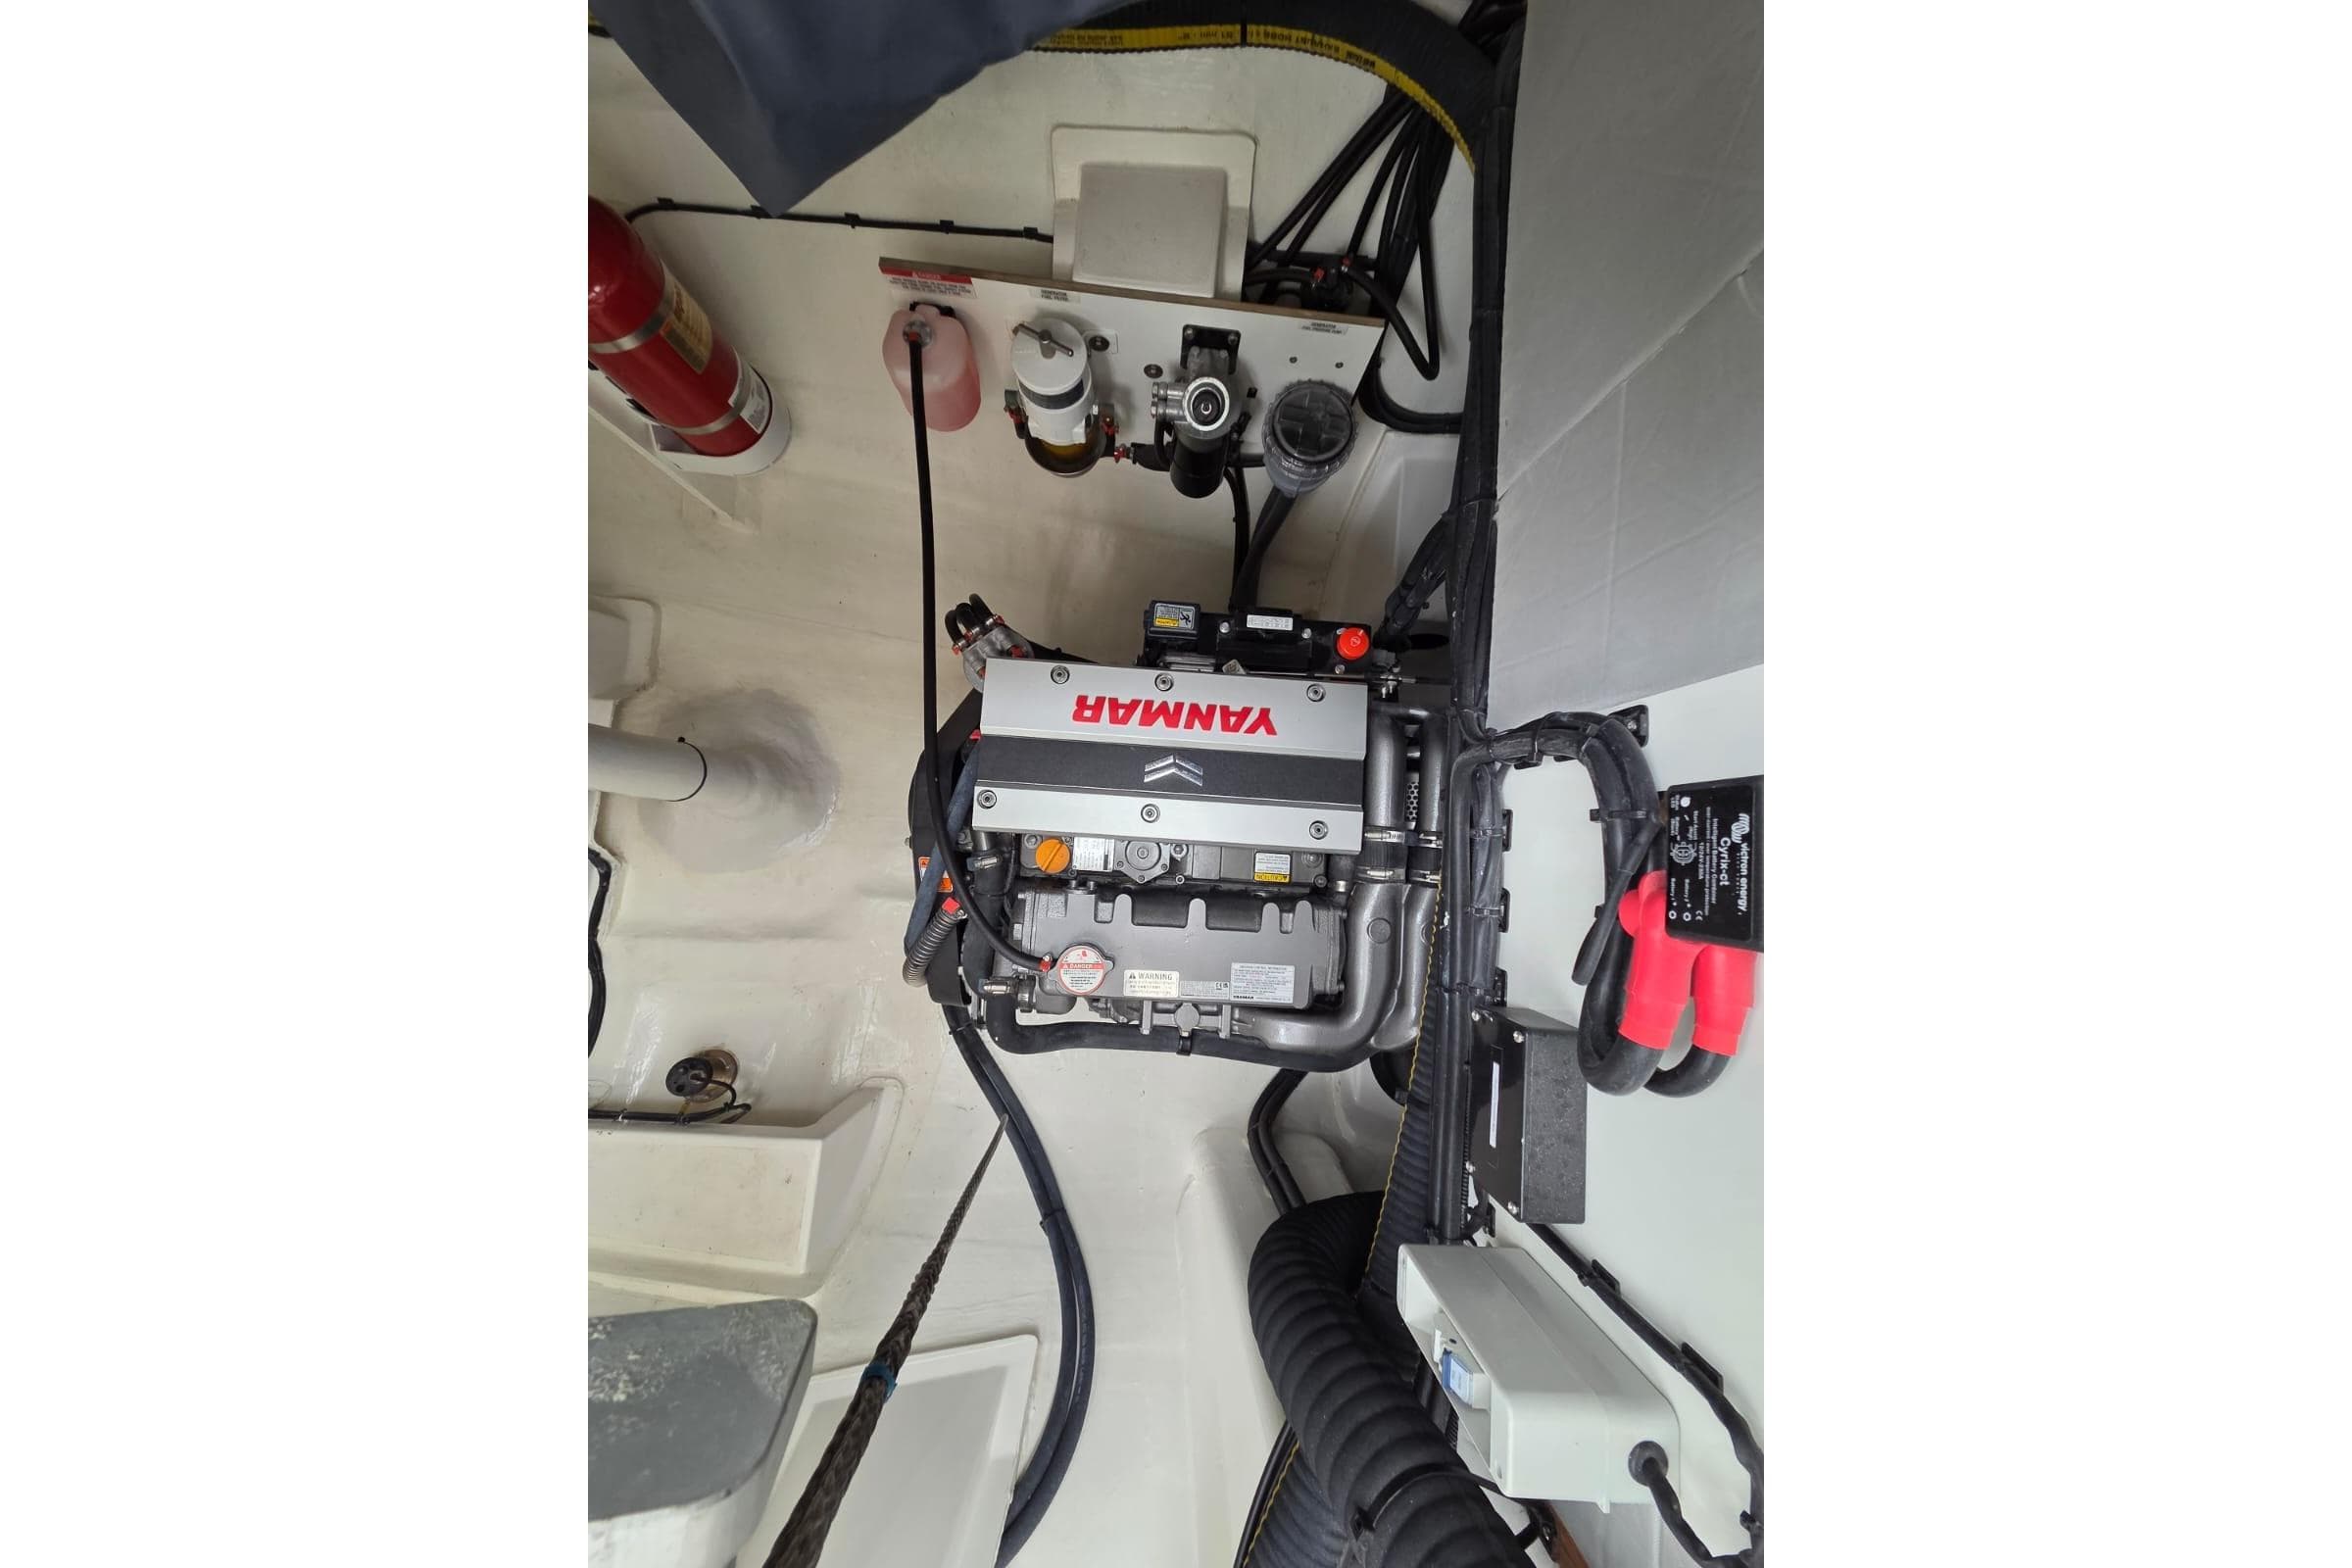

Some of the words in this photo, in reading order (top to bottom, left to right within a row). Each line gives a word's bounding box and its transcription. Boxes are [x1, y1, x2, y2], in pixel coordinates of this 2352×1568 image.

[1072, 695, 1278, 736] YANMAR
[1718, 837, 1731, 886] Cyrix-ct
[1740, 843, 1750, 876] victron
[1737, 877, 1748, 911] energy
[1138, 972, 1173, 981] WARNING
